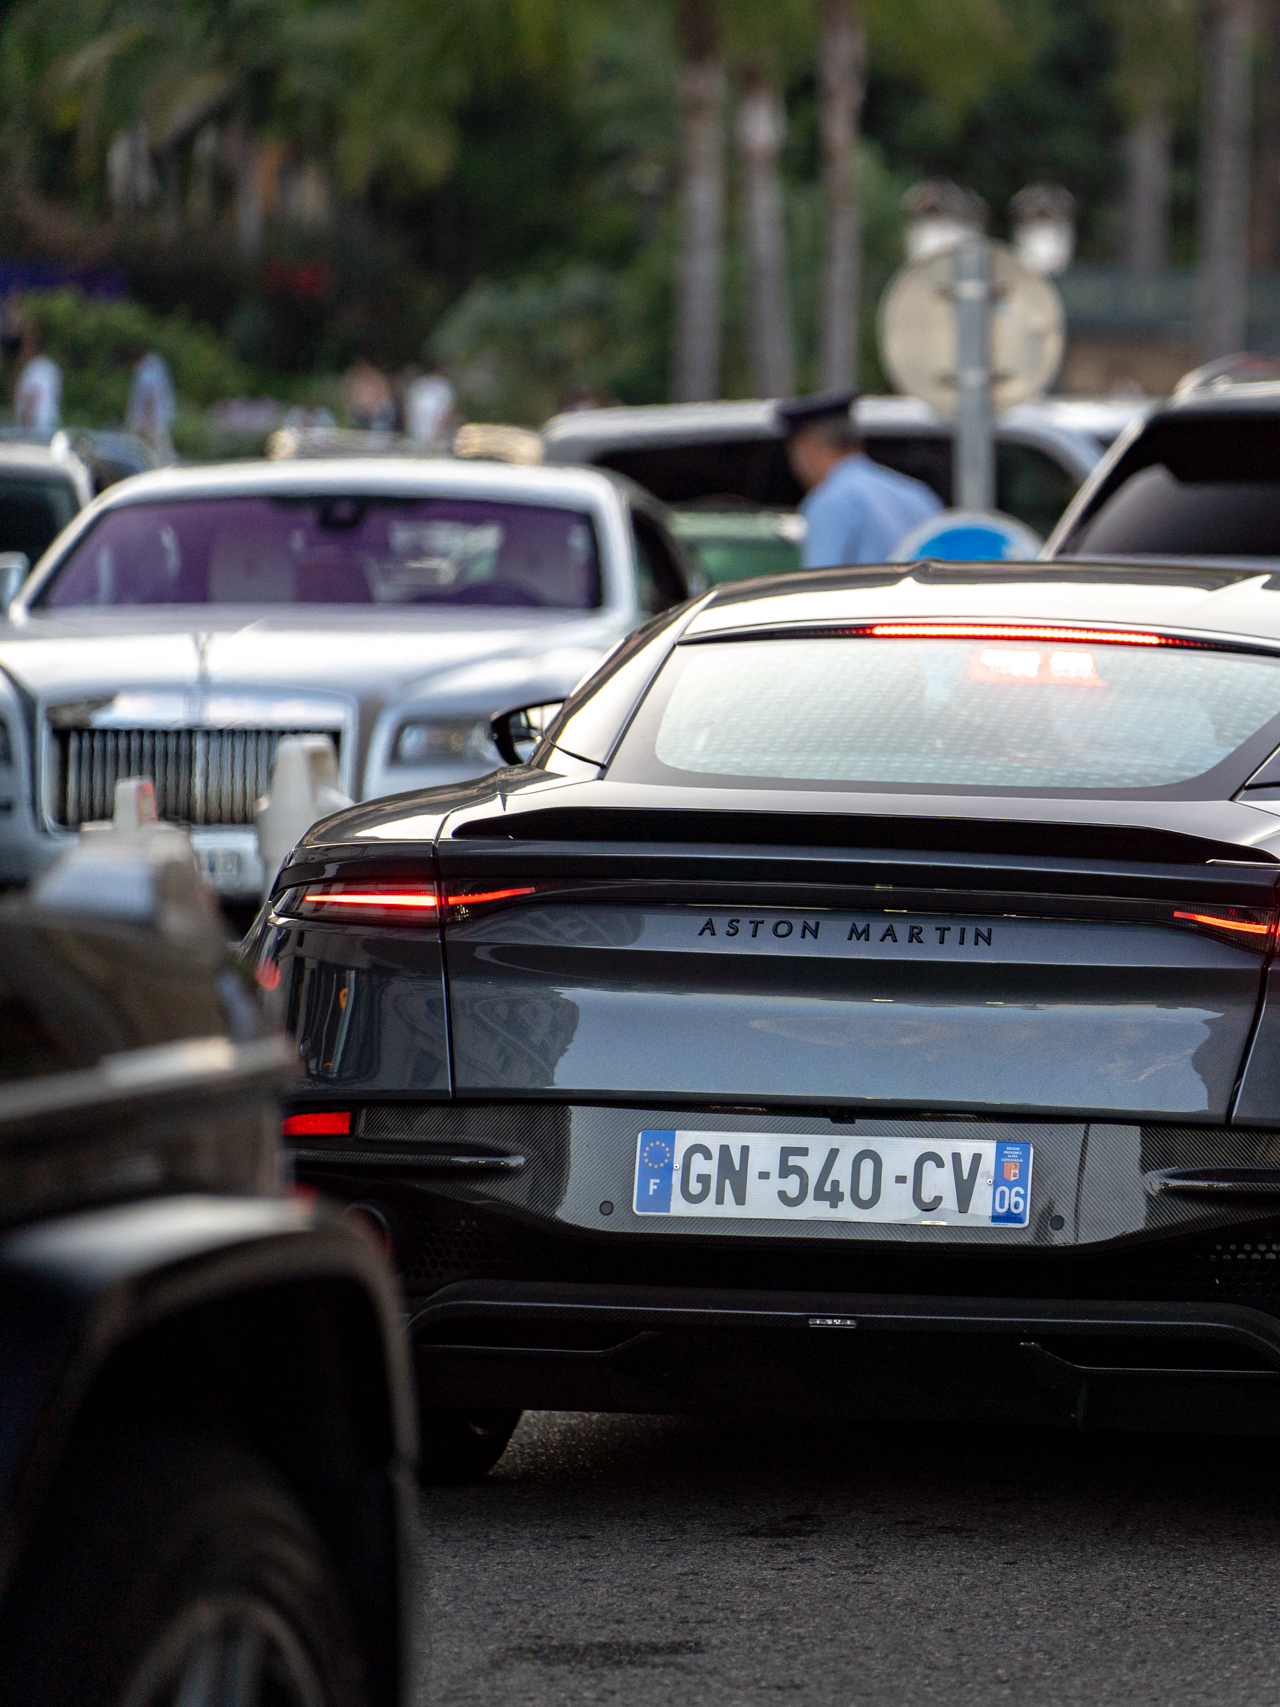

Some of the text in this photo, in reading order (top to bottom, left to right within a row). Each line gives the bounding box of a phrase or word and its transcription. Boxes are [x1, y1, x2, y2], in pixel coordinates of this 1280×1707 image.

[698, 917, 993, 946] ASTON MARTIN
[649, 1178, 660, 1196] F
[680, 1143, 983, 1214] GN-540-CV
[994, 1185, 1025, 1214] 06
